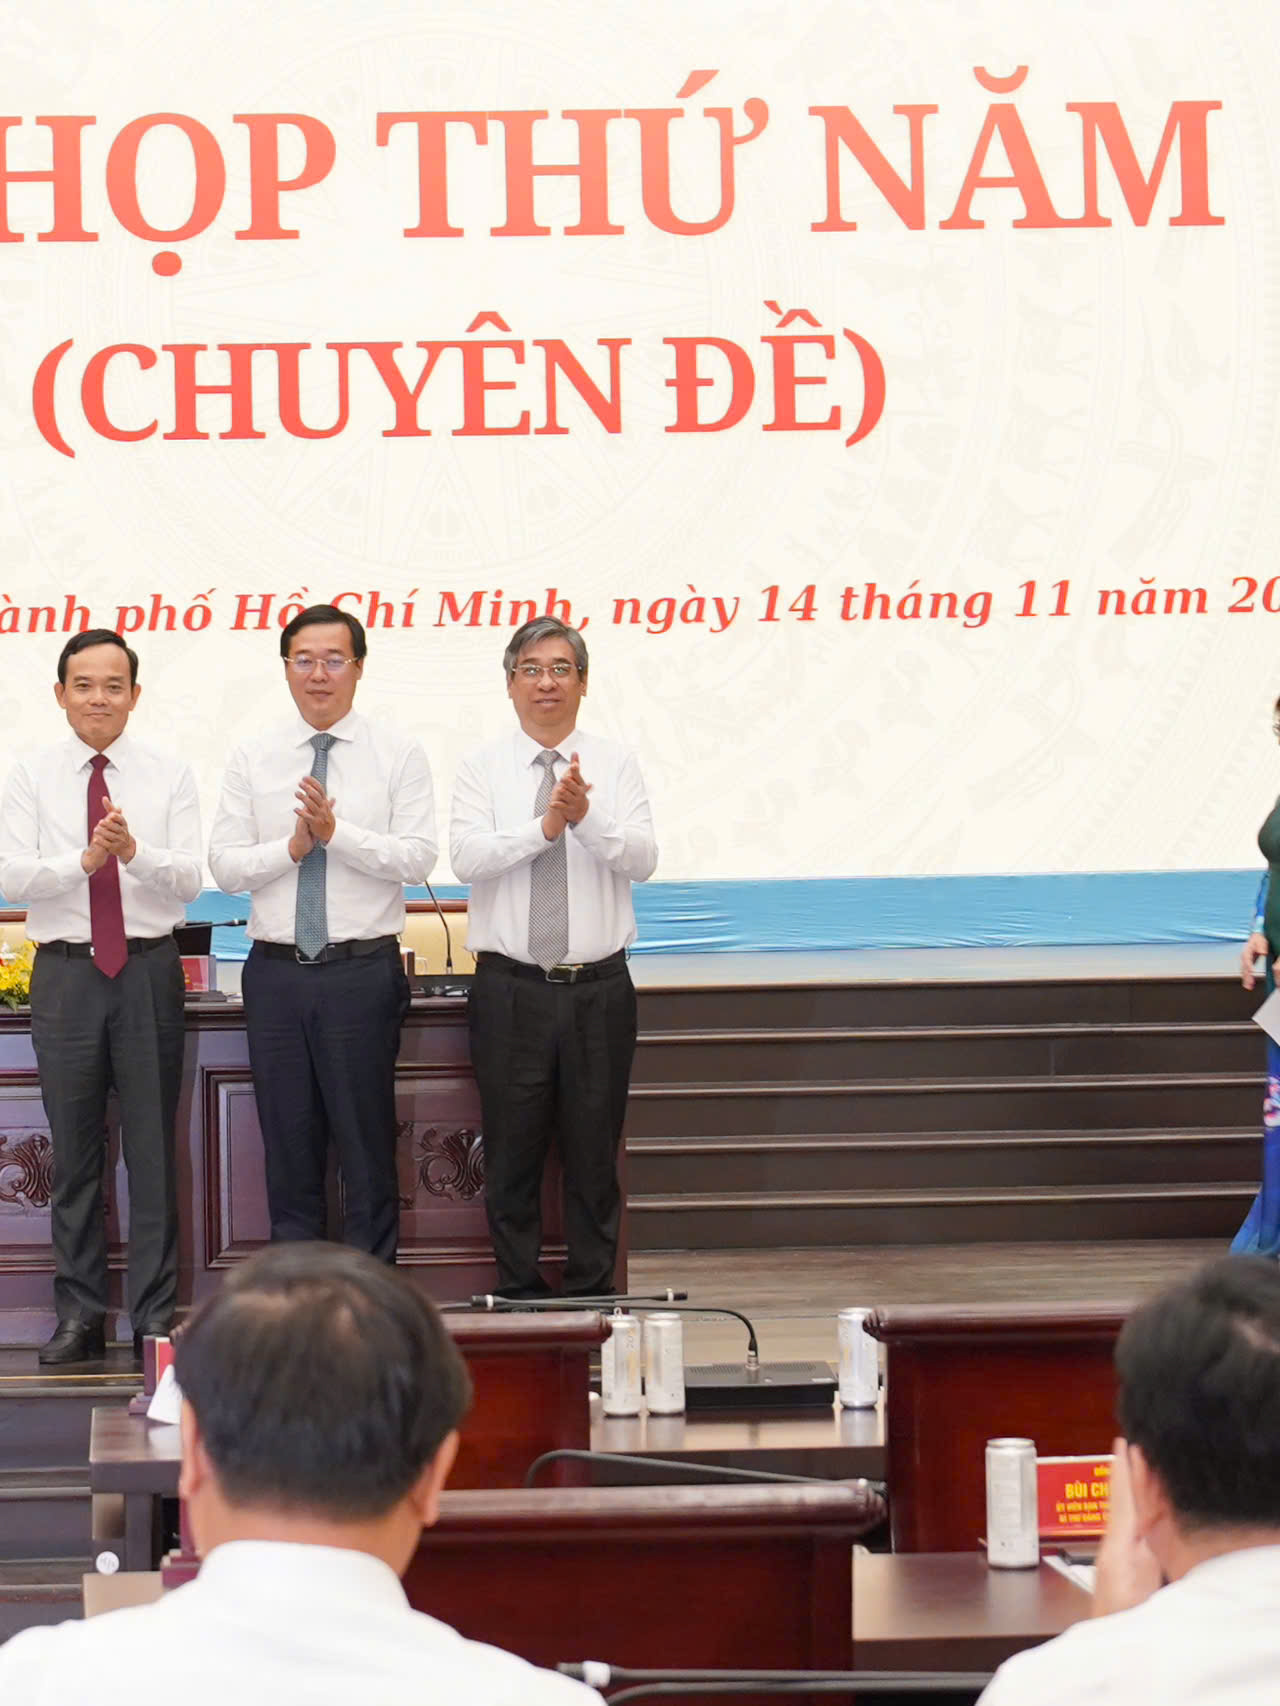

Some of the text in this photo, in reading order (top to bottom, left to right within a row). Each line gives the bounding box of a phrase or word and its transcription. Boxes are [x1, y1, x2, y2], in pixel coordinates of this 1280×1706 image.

[375, 69, 770, 239] THỨ
[808, 64, 1227, 233] NĂM
[31, 299, 887, 459] (CHUYÊN ĐỀ)
[115, 587, 217, 638] phố
[230, 586, 310, 631] Hồ
[432, 588, 590, 633] Minh,
[612, 584, 740, 635] ngày
[758, 584, 819, 622] 14
[839, 580, 993, 629] tháng
[1014, 579, 1072, 618] 11
[1097, 577, 1209, 616] năm
[1065, 1480, 1088, 1499] BÙI
